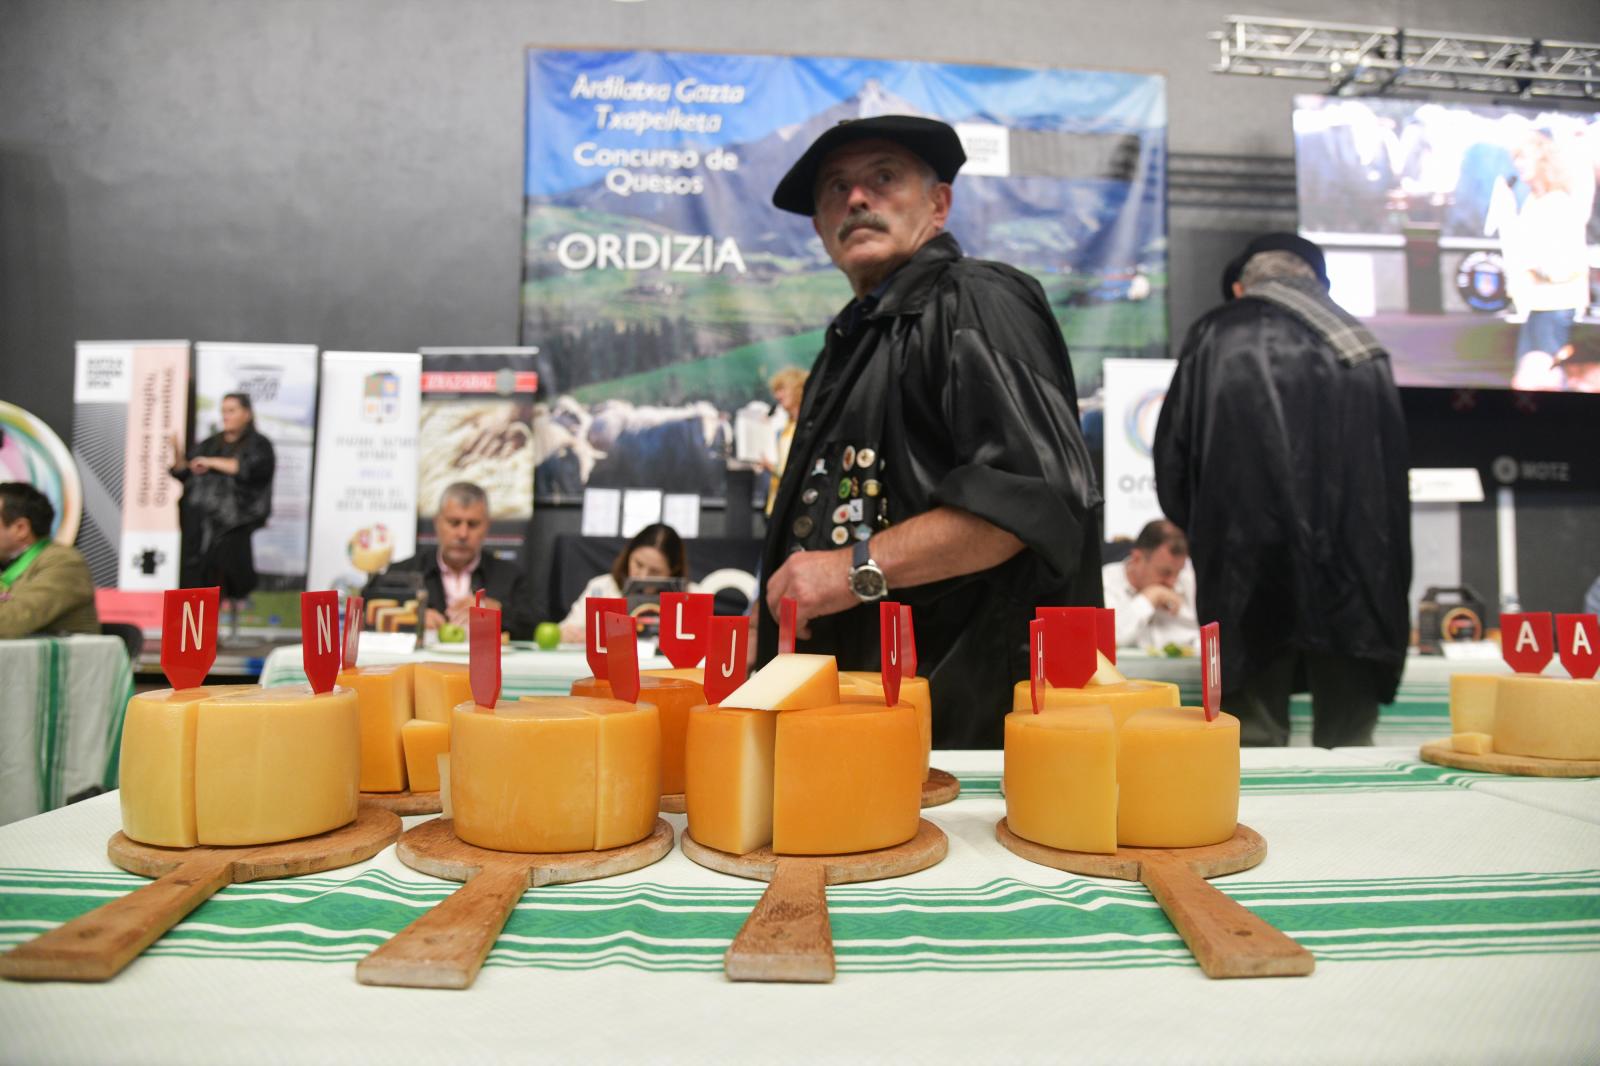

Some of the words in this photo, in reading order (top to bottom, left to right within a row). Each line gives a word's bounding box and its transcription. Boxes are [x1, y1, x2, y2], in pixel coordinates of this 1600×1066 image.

[570, 73, 671, 102] Ardilatxa
[675, 77, 745, 104] Gazta
[594, 104, 722, 136] Txapelketa
[573, 141, 699, 169] Concurso
[705, 147, 738, 171] de
[605, 168, 703, 197] Quesos
[557, 232, 747, 274] ORDIZIA
[181, 600, 204, 653] N
[316, 604, 332, 656] N
[676, 602, 696, 640] L
[1515, 620, 1540, 653] A
[1572, 621, 1593, 655] A
[721, 629, 737, 678] J
[891, 615, 897, 666] J
[1209, 635, 1218, 688] H
